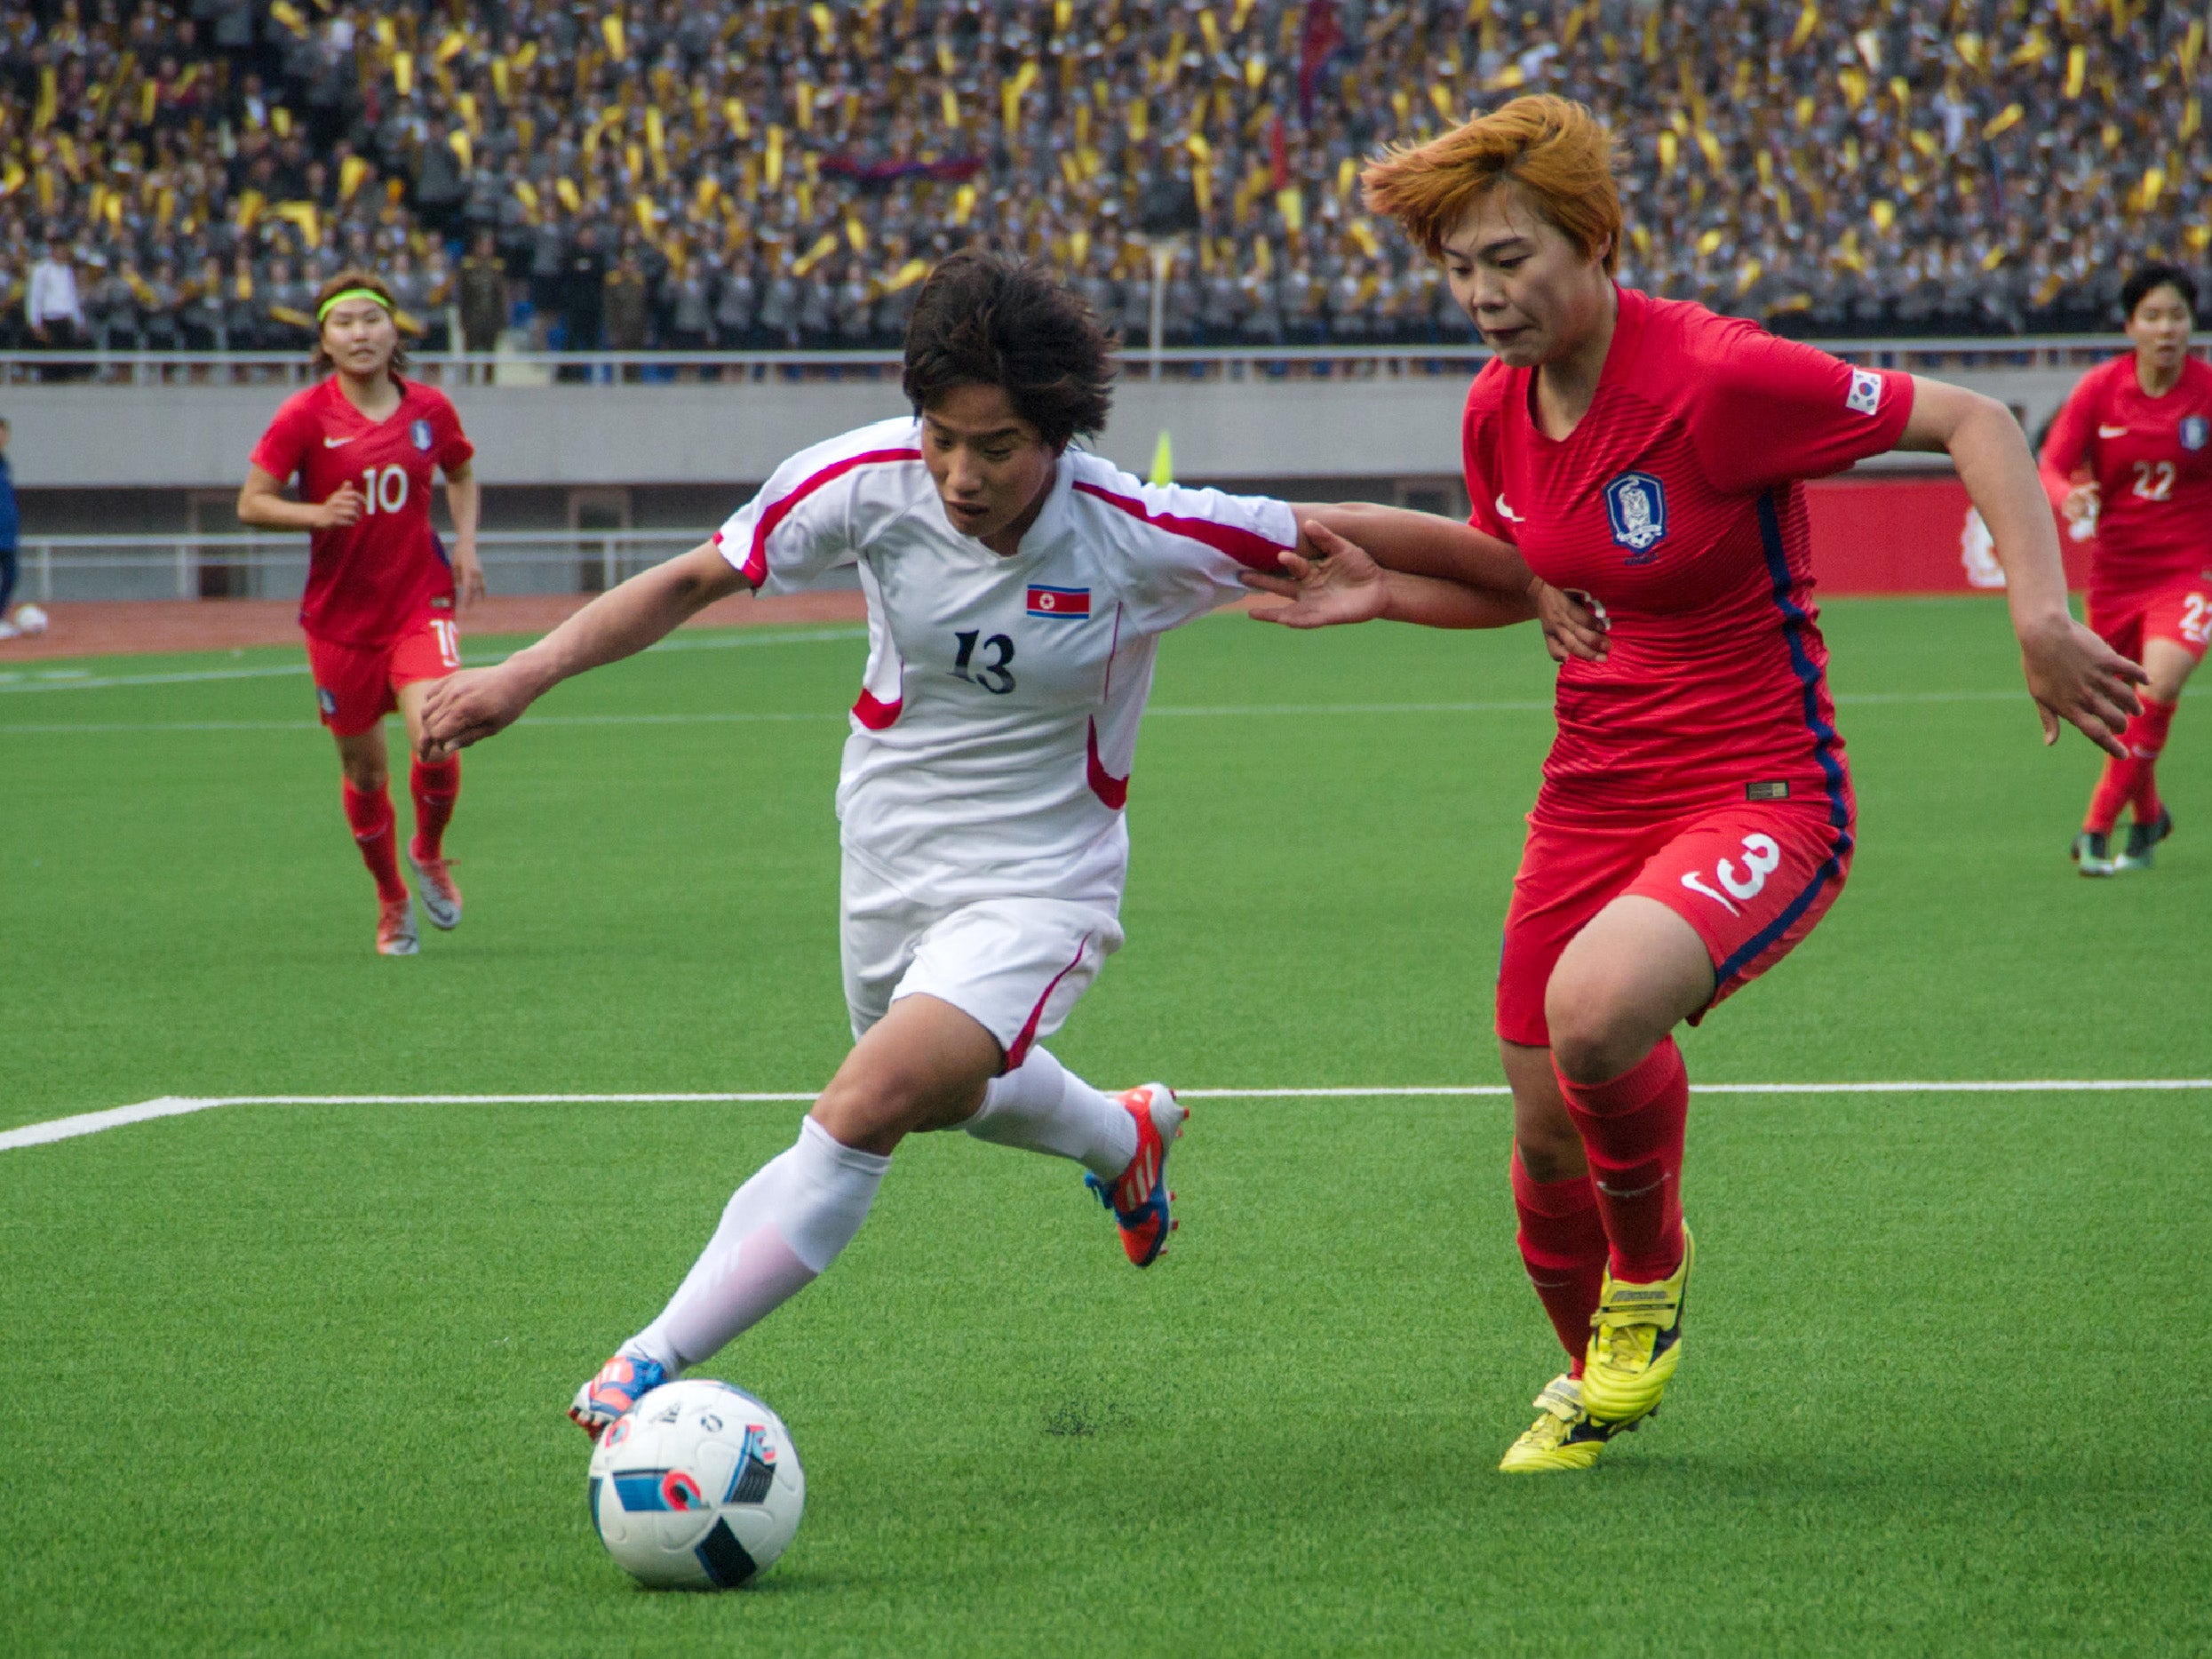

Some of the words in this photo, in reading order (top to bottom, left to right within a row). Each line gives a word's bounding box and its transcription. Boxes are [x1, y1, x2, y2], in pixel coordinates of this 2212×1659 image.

[362, 465, 408, 514] 10
[2132, 459, 2176, 502] 22
[946, 629, 1016, 695] 13
